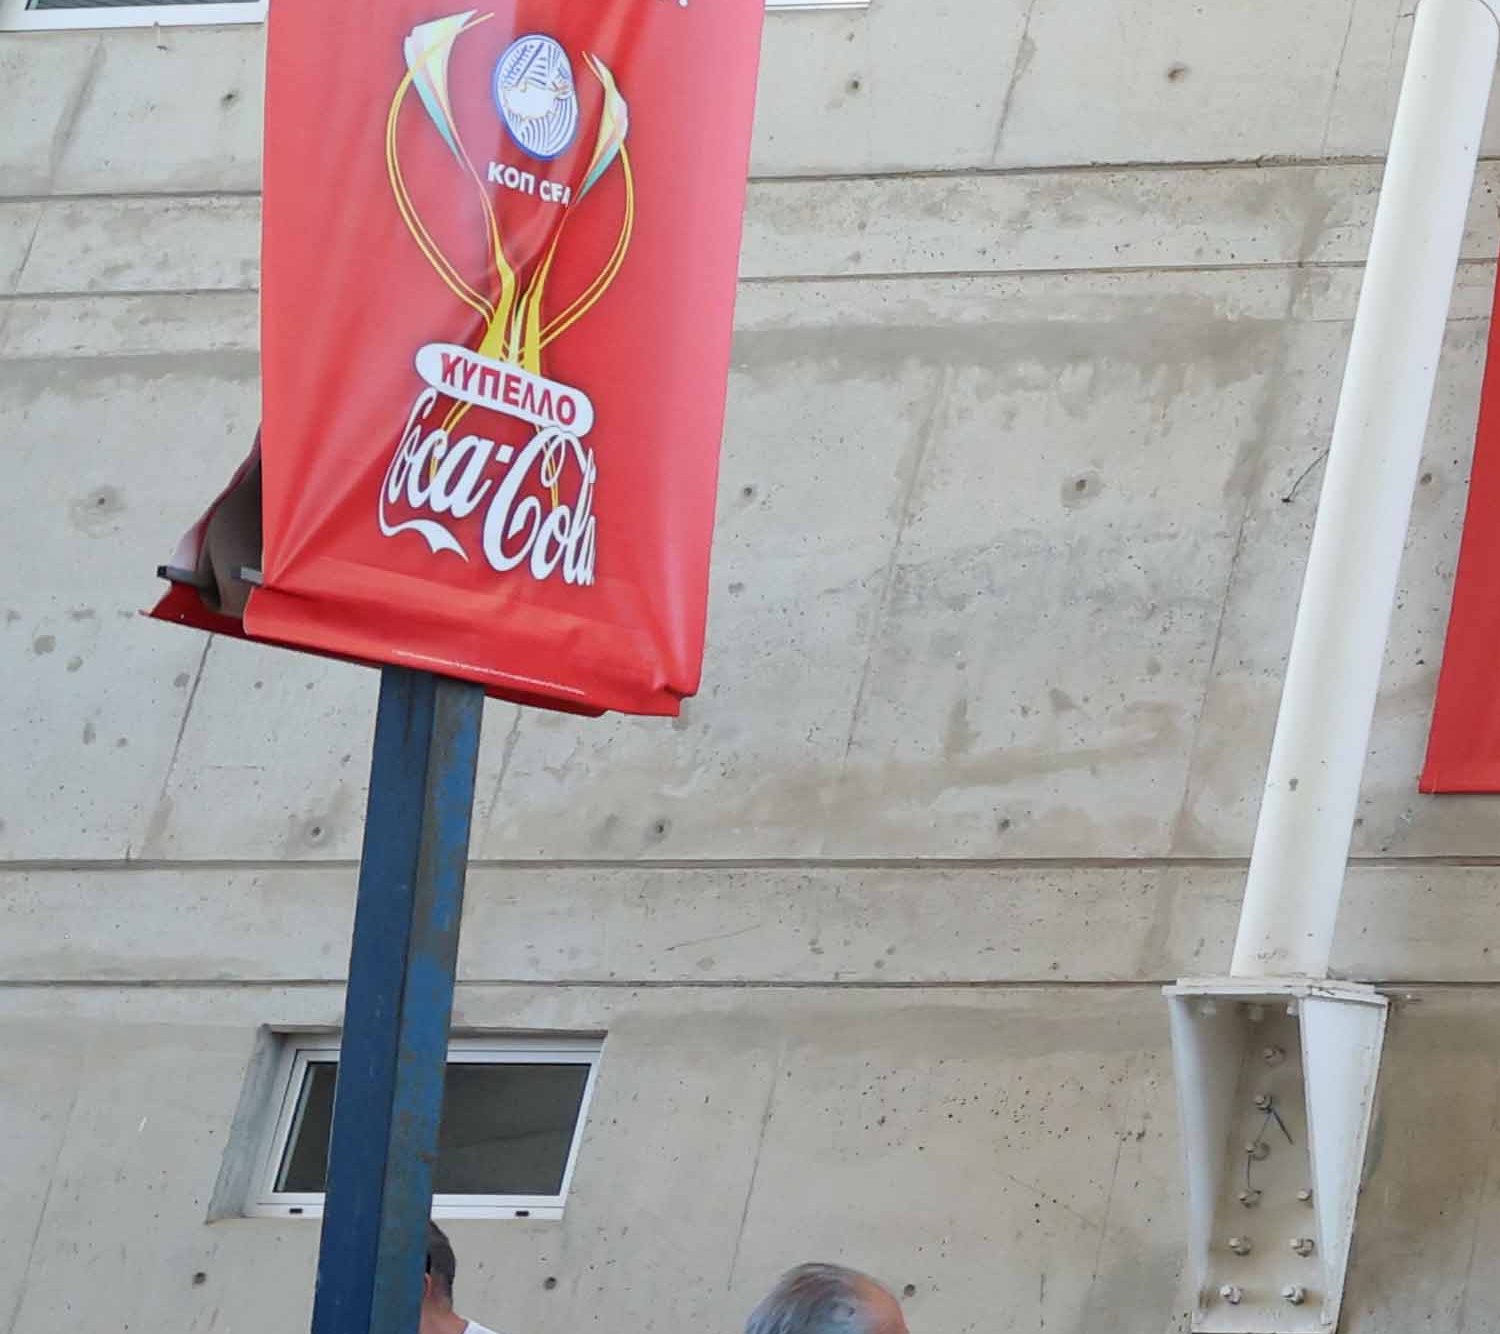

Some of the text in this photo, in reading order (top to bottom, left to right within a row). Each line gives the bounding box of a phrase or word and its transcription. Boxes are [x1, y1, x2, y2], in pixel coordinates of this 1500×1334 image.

[488, 161, 534, 194] ΚΟΠ
[441, 352, 576, 426] ΚΥΠΕΛΛΟ
[379, 388, 596, 586] Coca-Cola
